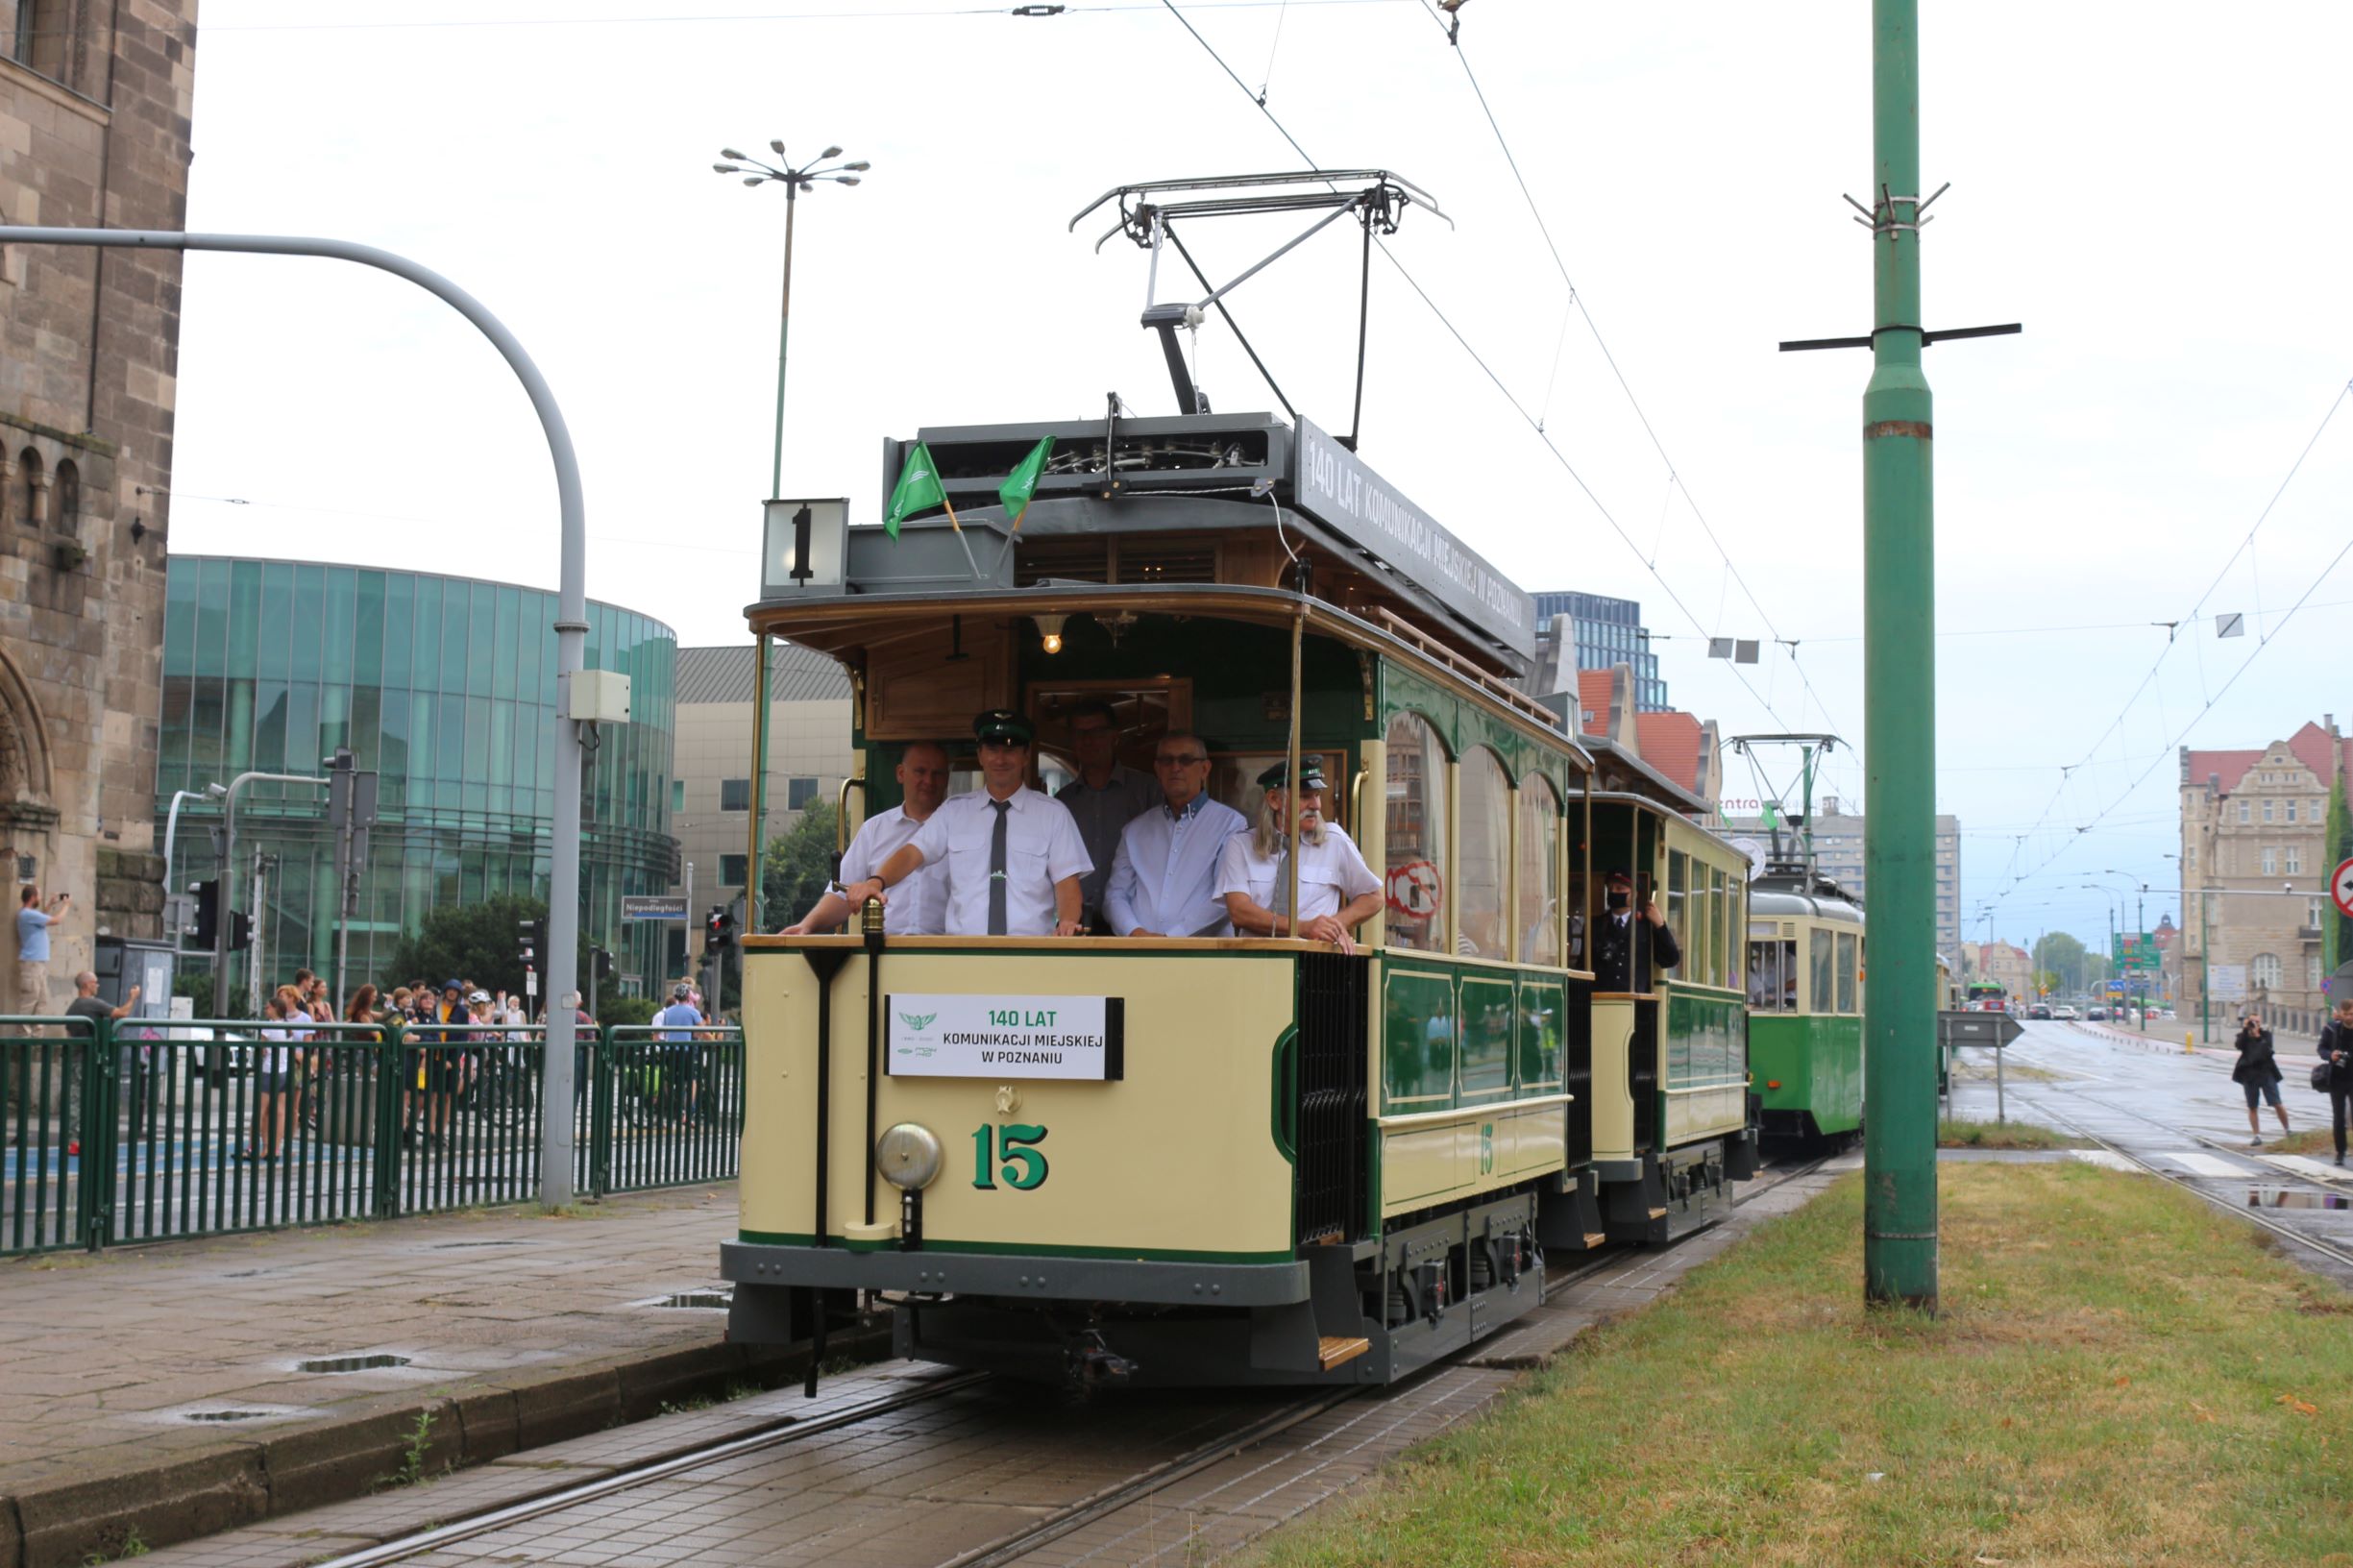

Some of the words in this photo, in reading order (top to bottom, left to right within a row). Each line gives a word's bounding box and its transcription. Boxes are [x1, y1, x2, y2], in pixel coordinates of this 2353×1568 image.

[790, 506, 814, 579] 1
[1309, 440, 1334, 499] 140
[1337, 461, 1361, 518] LAT
[1365, 482, 1432, 562] KOMUNIKACJI
[1434, 533, 1477, 595] MIEJSKIEJ
[1478, 568, 1487, 602] W
[1486, 576, 1522, 627] POZNANIU
[943, 1032, 1031, 1046] KOMUNIKACJI
[1035, 1034, 1103, 1048] MIEJSKIEJ
[988, 1010, 1019, 1027] 140
[1025, 1010, 1058, 1027] LAT
[981, 1050, 994, 1063] W
[997, 1050, 1063, 1065] POZNANIU
[971, 1122, 1049, 1191] 15
[1480, 1122, 1493, 1176] 15
